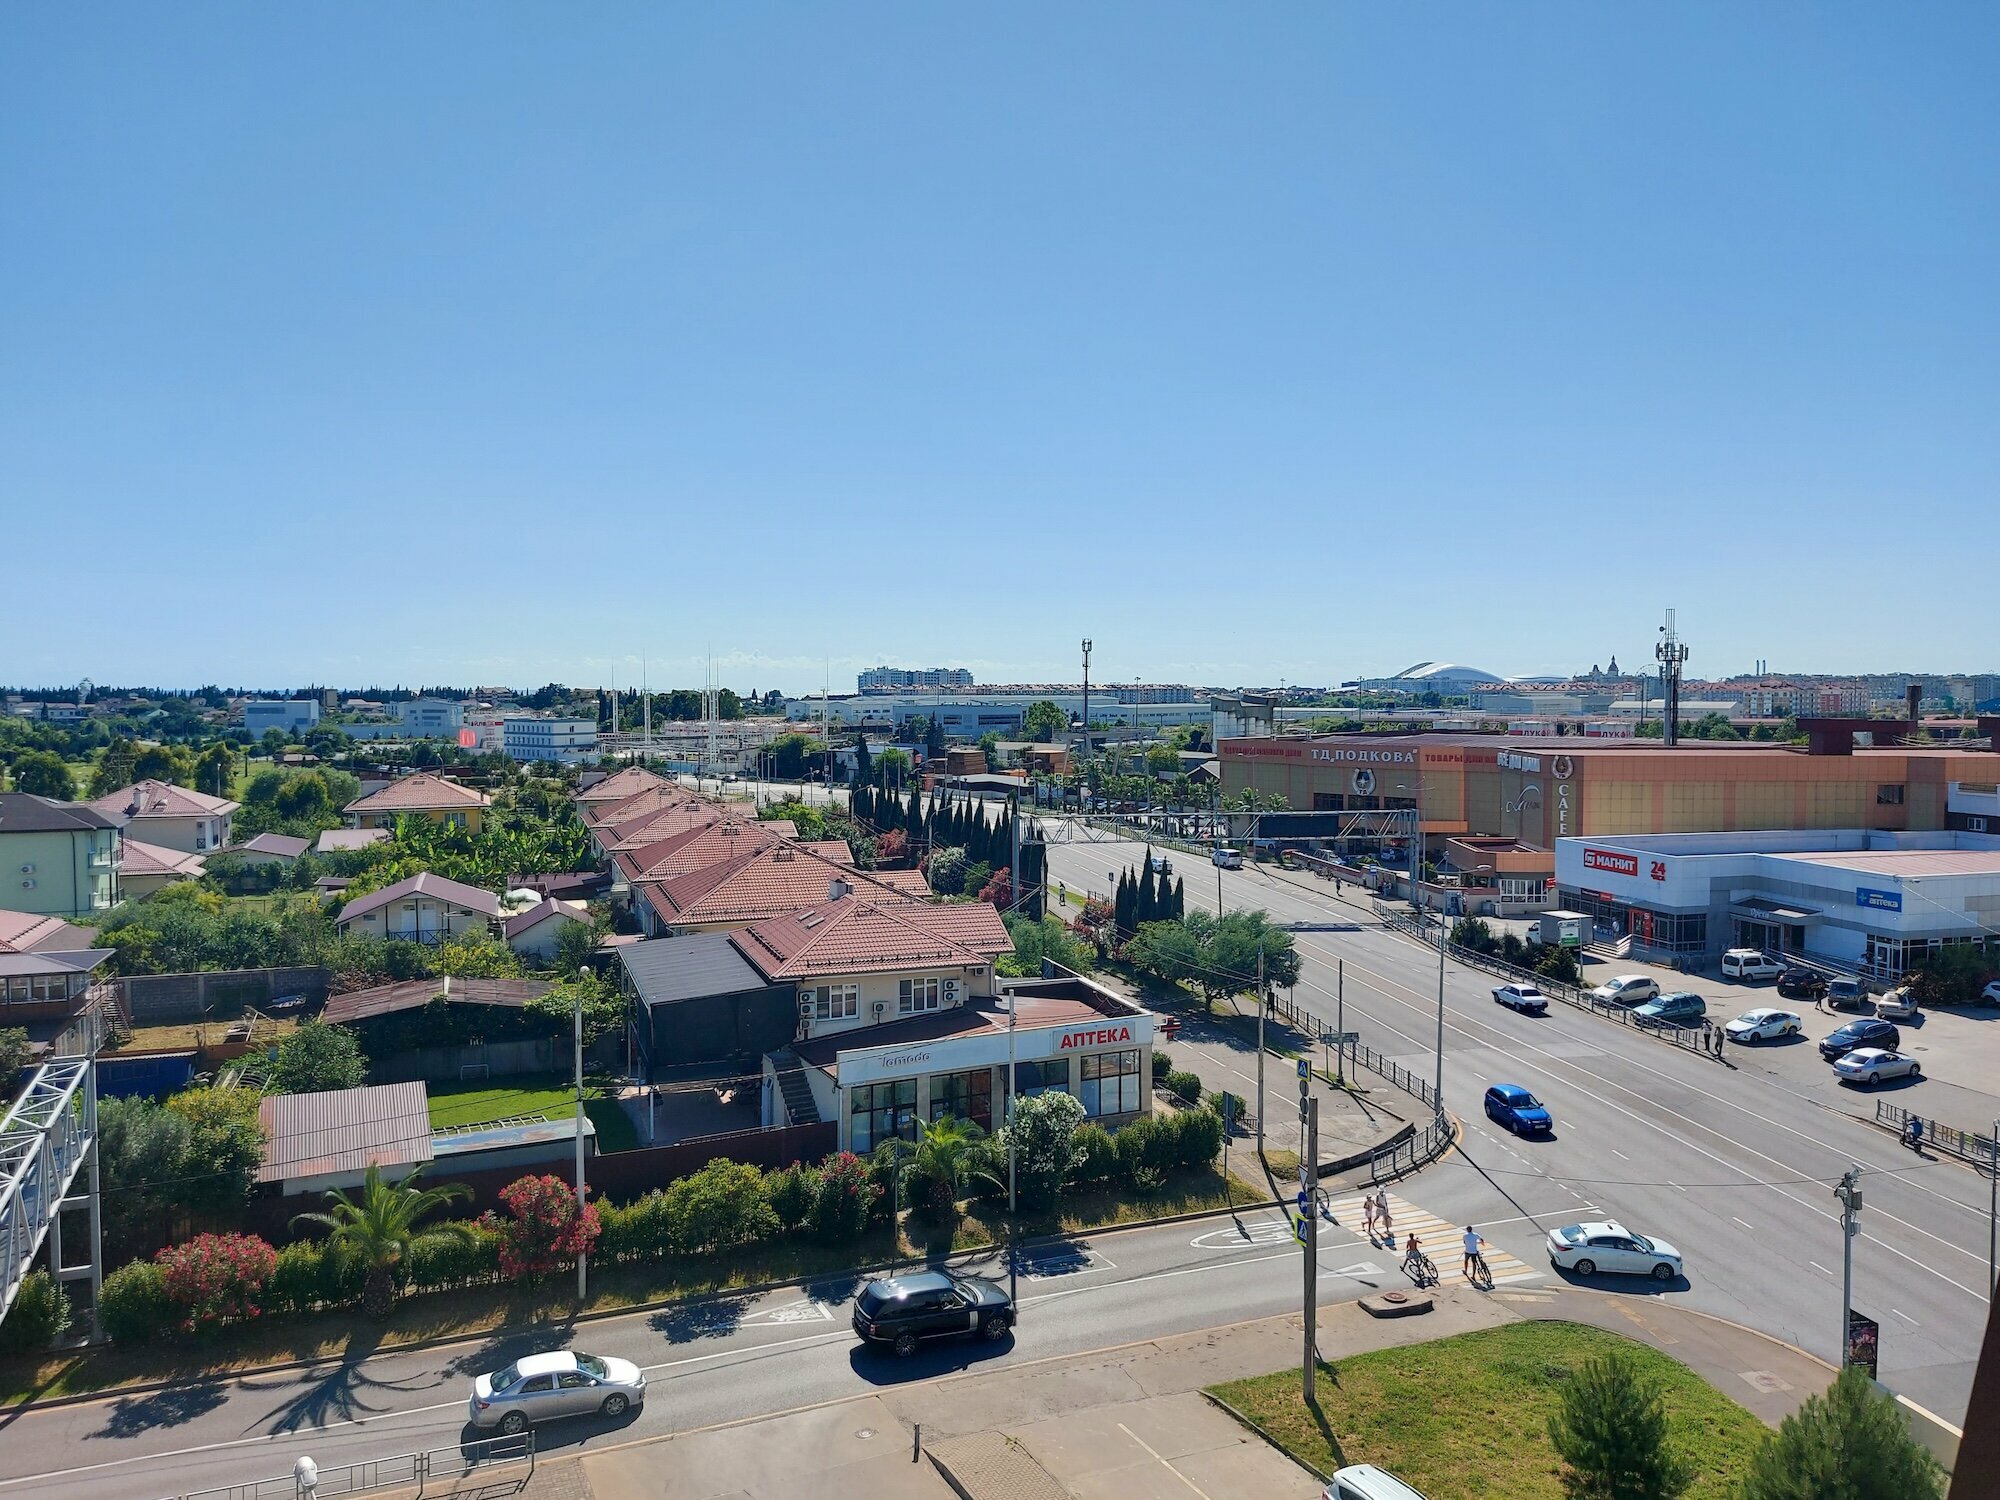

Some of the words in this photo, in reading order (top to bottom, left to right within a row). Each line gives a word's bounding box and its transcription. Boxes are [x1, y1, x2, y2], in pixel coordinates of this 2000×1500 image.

[1425, 754, 1463, 762] ТОВАРЫ
[1558, 784, 1569, 835] CAFE
[1596, 855, 1635, 871] МАГНИТ
[1651, 861, 1666, 875] 24
[1869, 898, 1899, 908] аптека
[1060, 1026, 1131, 1049] АПТЕКА
